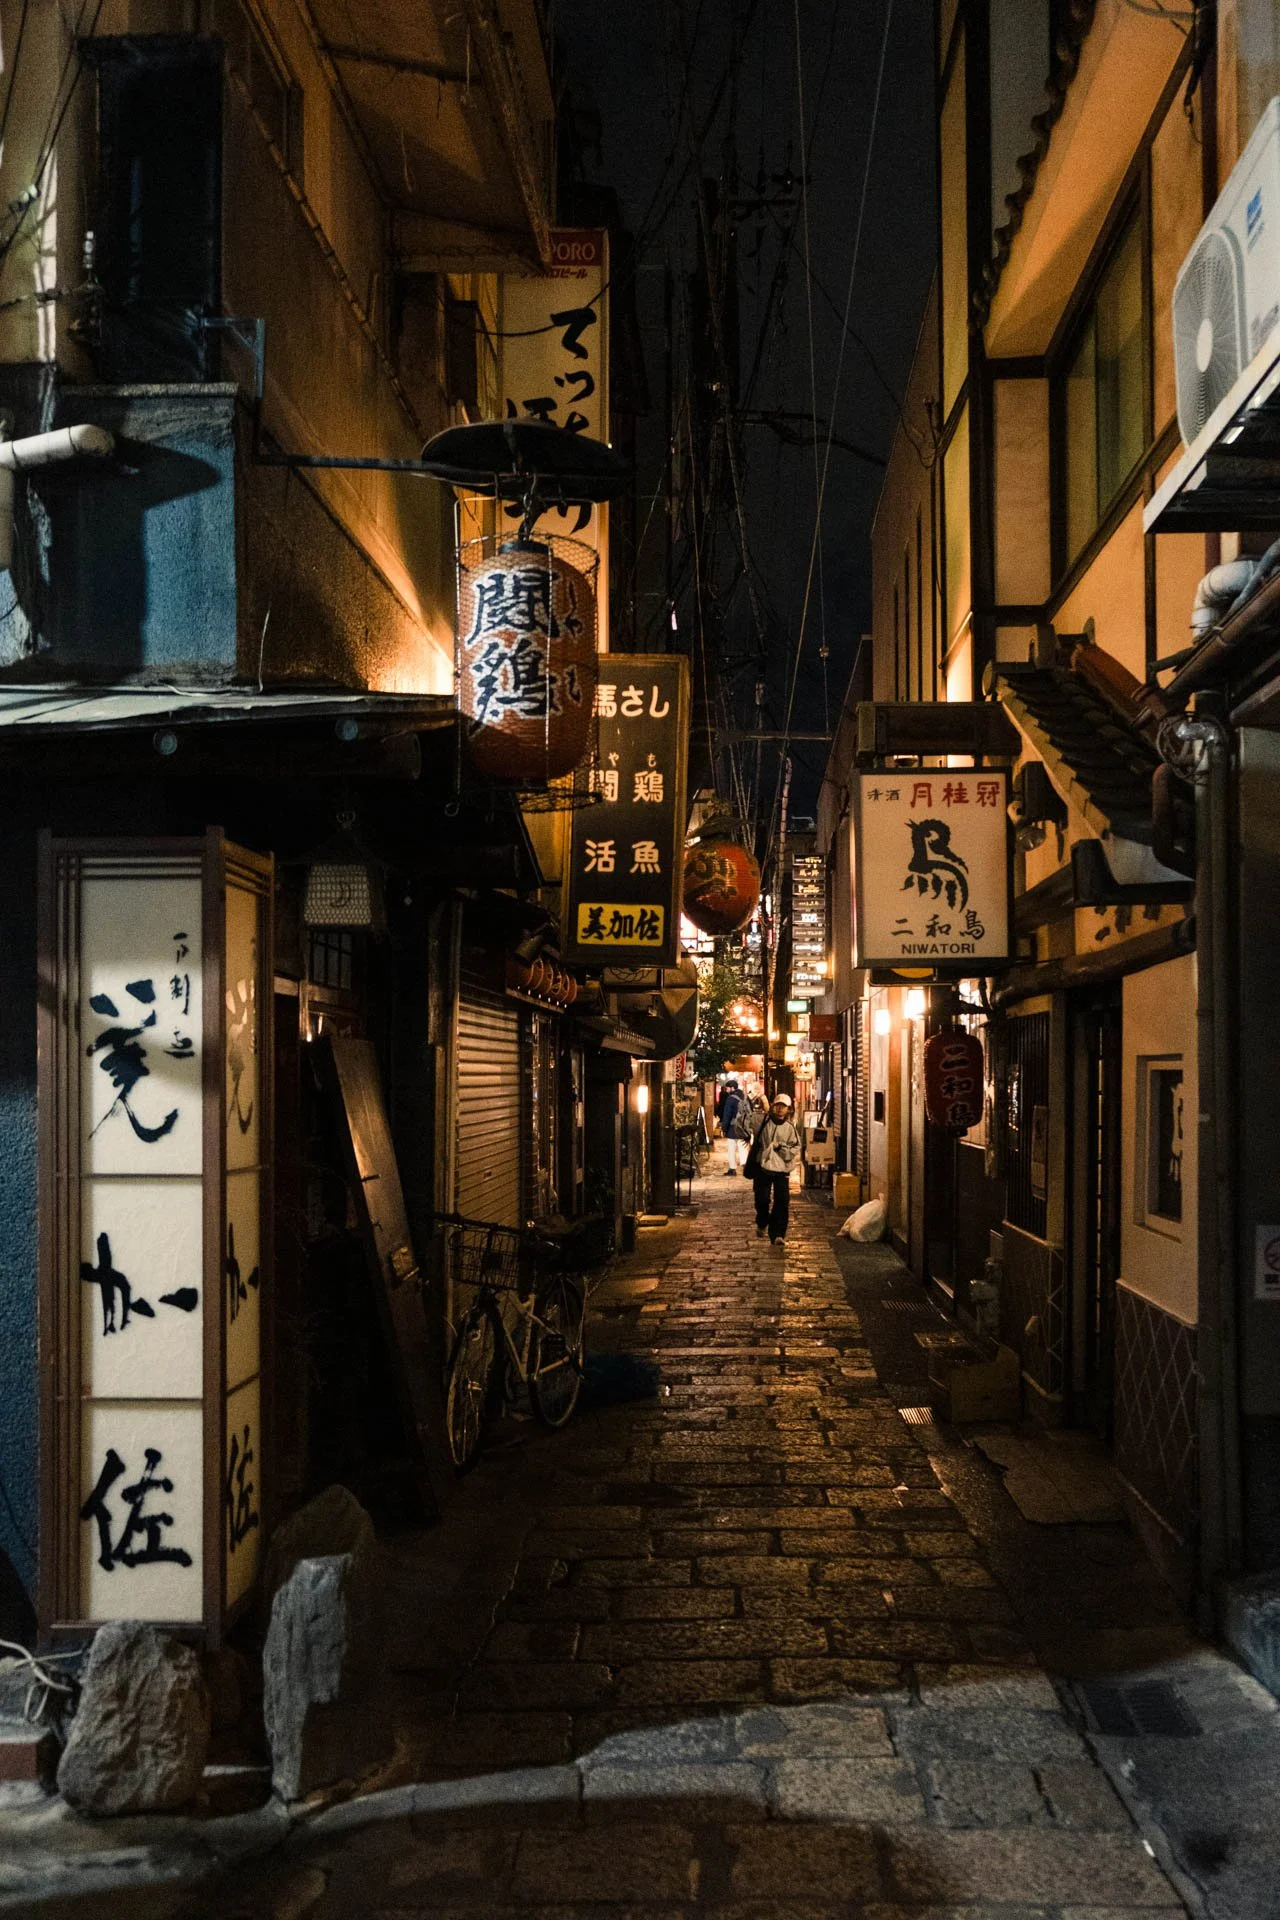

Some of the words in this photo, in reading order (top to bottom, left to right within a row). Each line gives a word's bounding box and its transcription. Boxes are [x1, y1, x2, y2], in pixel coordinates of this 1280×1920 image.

[592, 684, 670, 718] 馬さし
[867, 788, 900, 801] 清酒
[910, 781, 1000, 808] 月桂冠
[584, 839, 661, 873] 活魚
[581, 905, 660, 941] 美加佐
[891, 910, 985, 940] 二和鳥
[902, 943, 975, 954] NIWATORI
